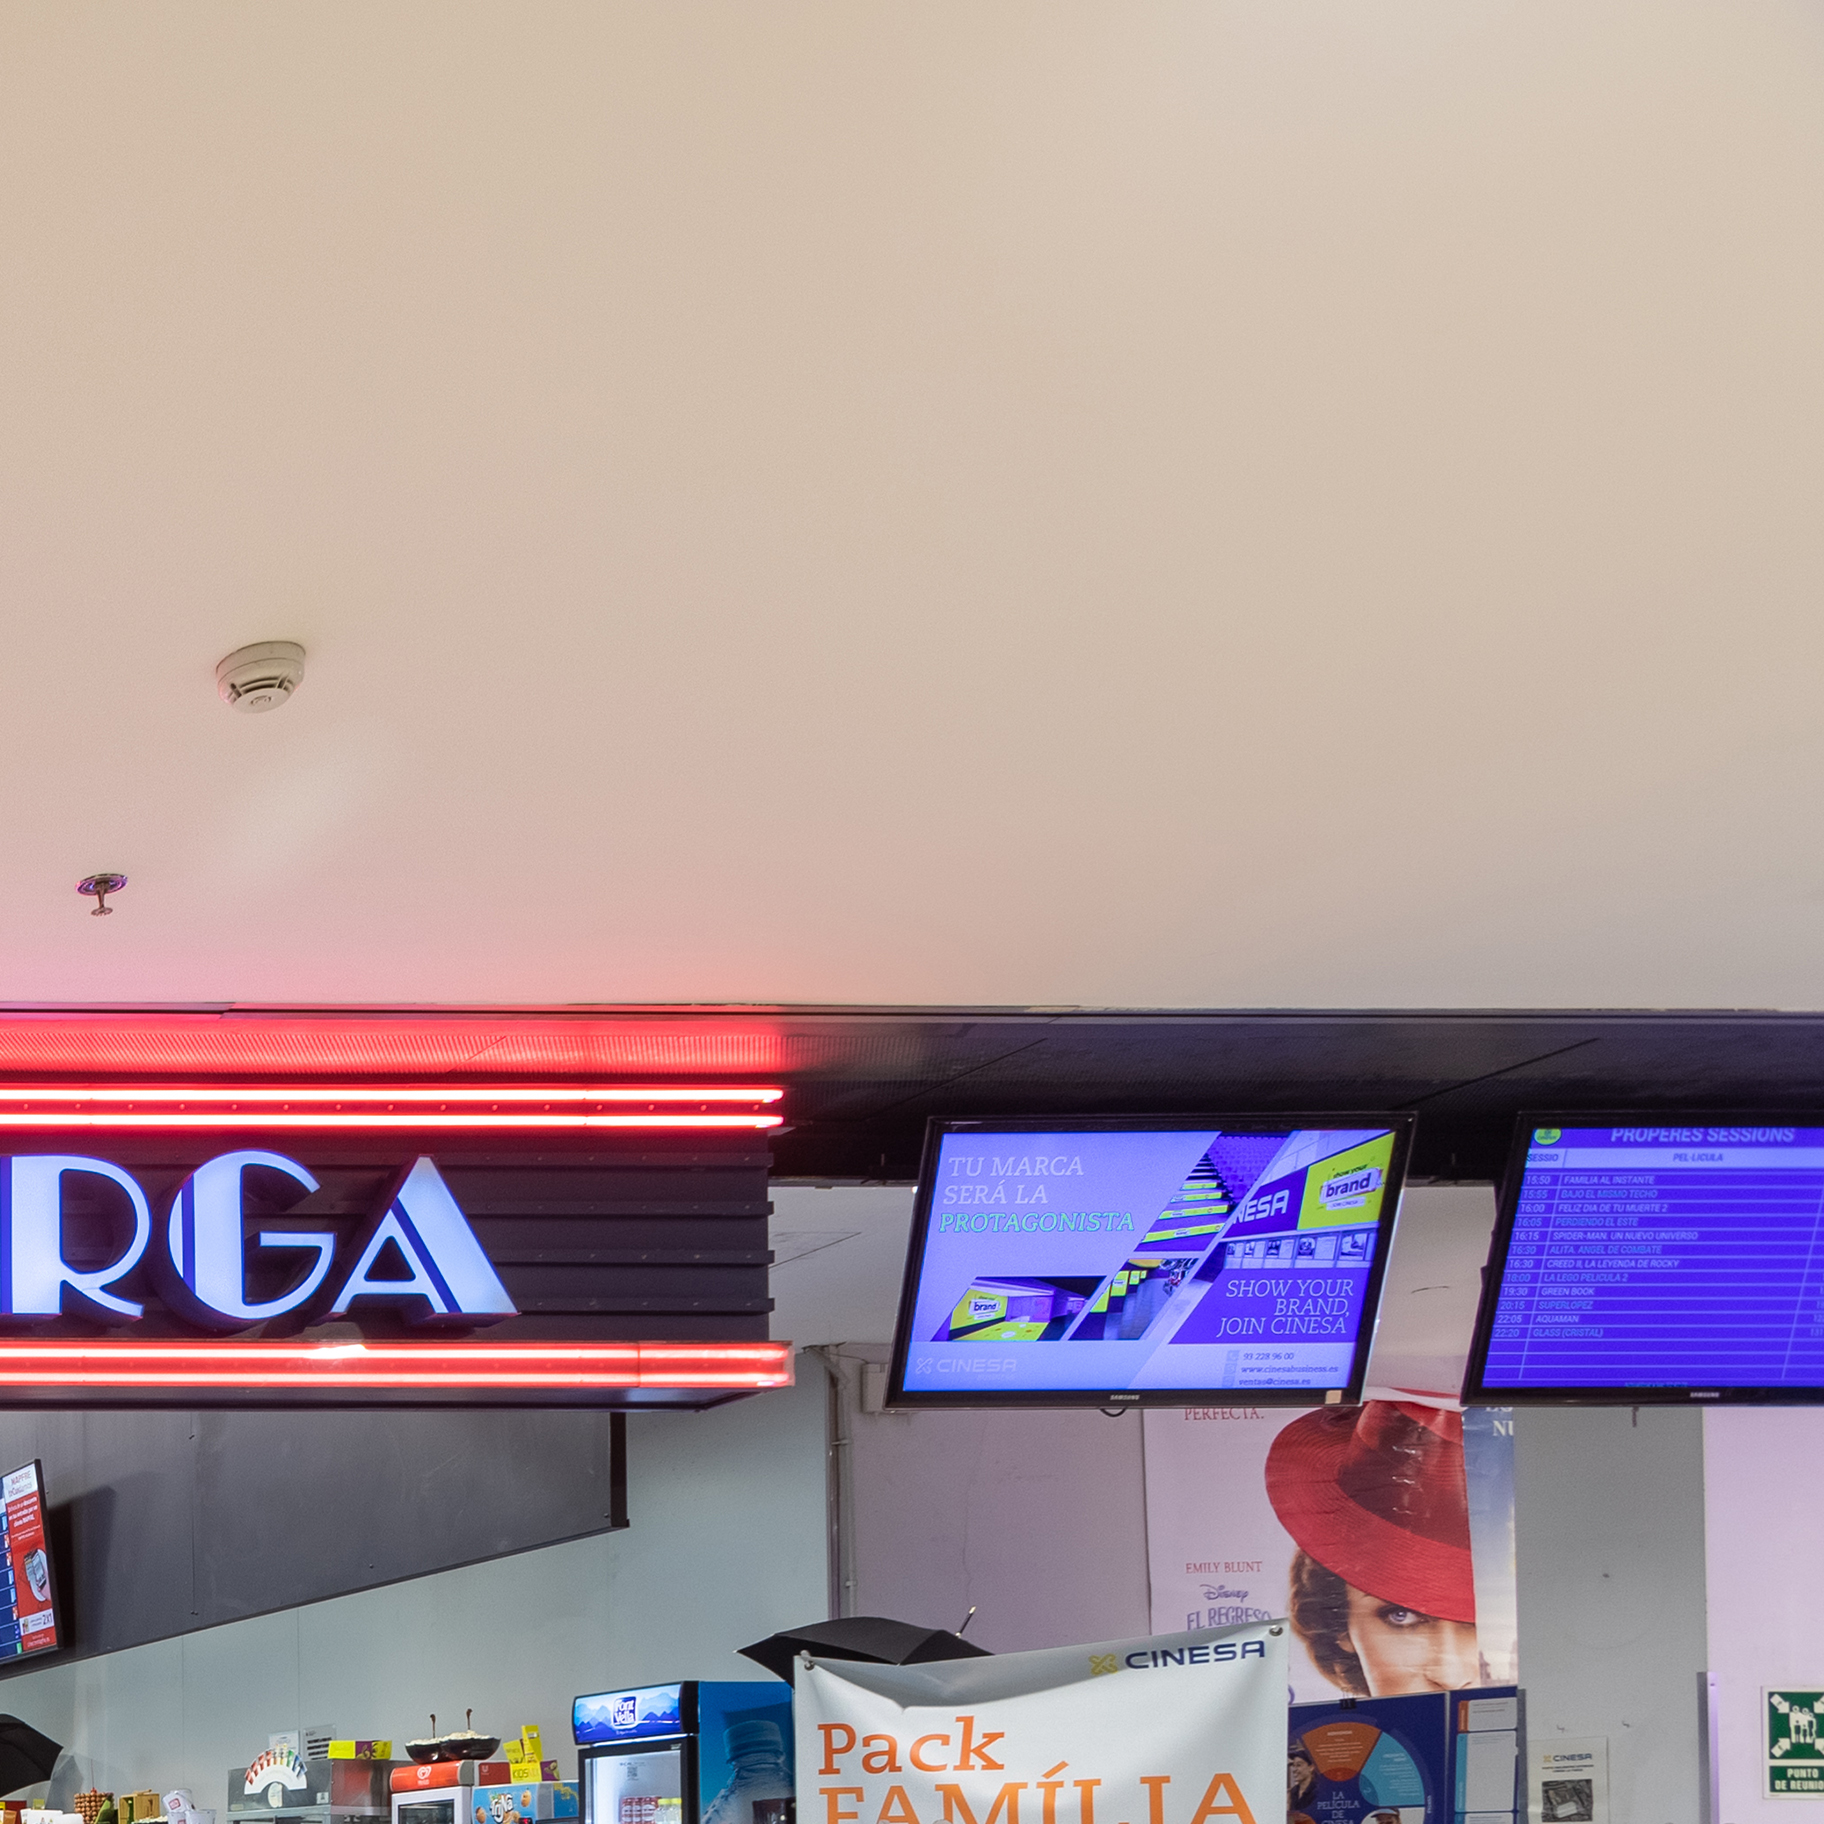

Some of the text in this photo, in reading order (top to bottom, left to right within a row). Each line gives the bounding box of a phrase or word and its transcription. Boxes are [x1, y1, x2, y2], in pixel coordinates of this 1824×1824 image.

[1611, 1128, 1796, 1142] PROPERES SESSIONS
[948, 1156, 1084, 1178] TU MARCA
[943, 1180, 1050, 1204] SERÁ LA
[1325, 1172, 1372, 1198] brand
[939, 1212, 1134, 1234] PROTAGONISTA
[1226, 1279, 1354, 1298] SHOW YOUR
[1273, 1298, 1350, 1318] BRAND,
[1217, 1316, 1348, 1338] JOIN CINESA
[936, 1358, 1018, 1374] CINESA
[1185, 1561, 1263, 1574] EMILY BLUNT
[1200, 1584, 1250, 1602] Disney
[1125, 1639, 1266, 1670] CINESA
[817, 1716, 1006, 1776] Pack
[1786, 1768, 1820, 1778] PUNTO
[1774, 1780, 1788, 1792] DE
